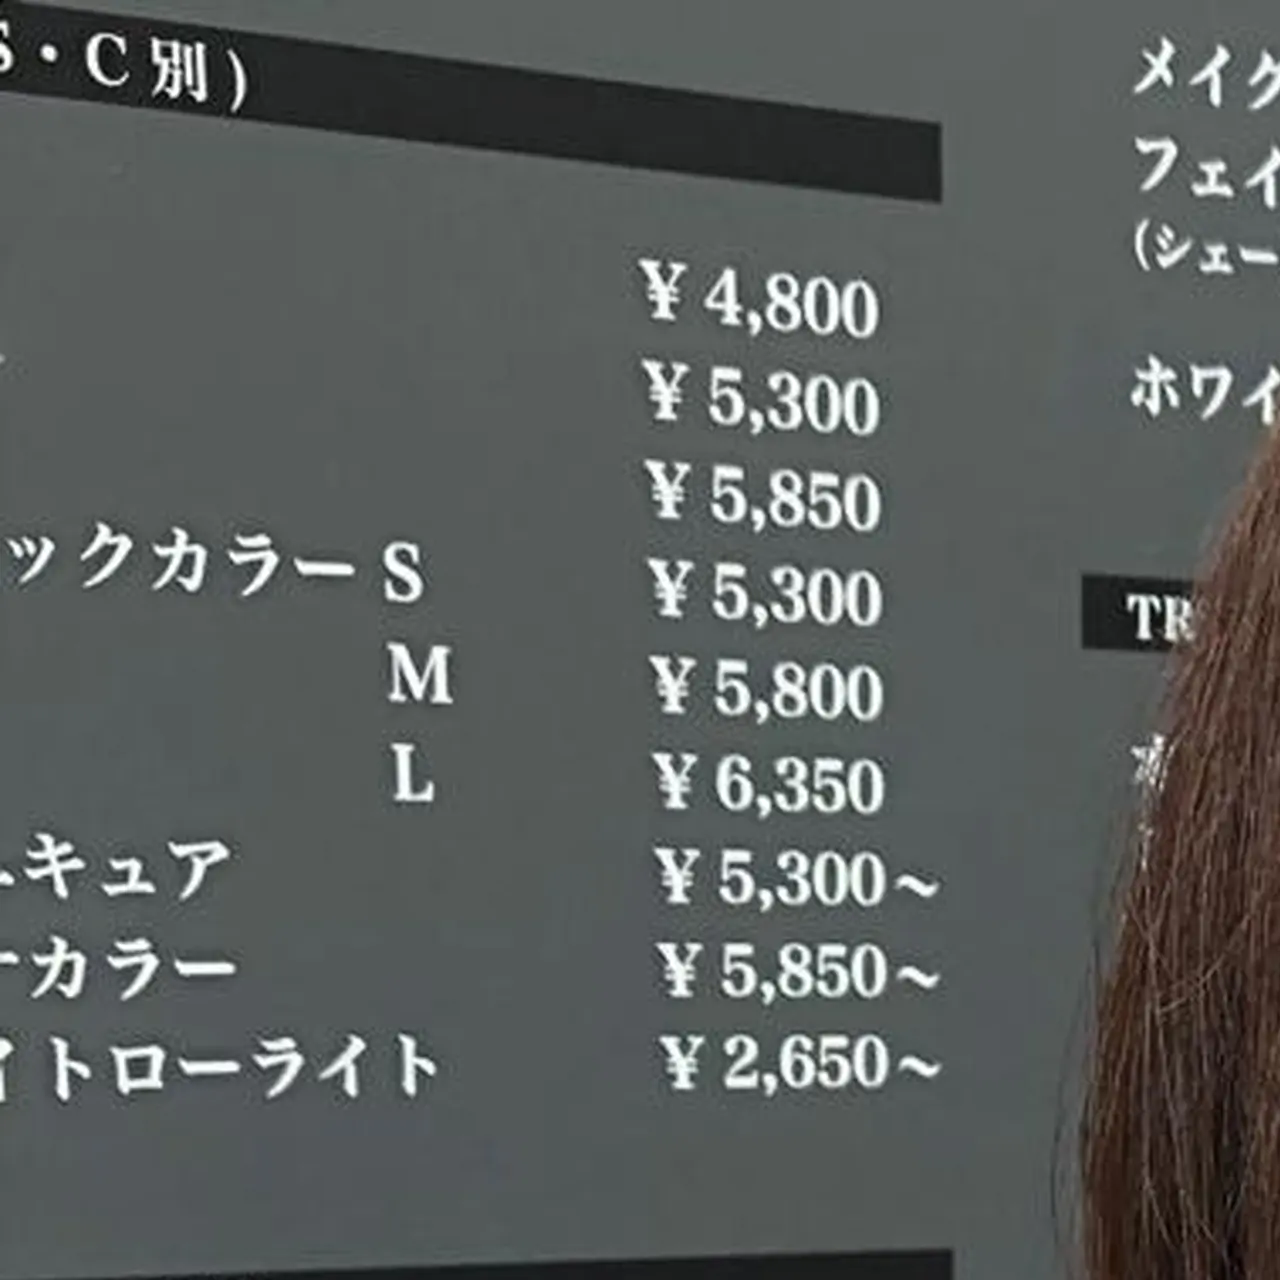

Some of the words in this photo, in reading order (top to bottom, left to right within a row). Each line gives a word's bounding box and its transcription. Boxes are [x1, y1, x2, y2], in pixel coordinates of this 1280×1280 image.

[639, 258, 878, 338] ¥4,800
[642, 359, 879, 435] ¥5,300
[644, 459, 880, 532] ¥5,850
[384, 542, 423, 602] S
[647, 558, 882, 629] ¥5,300
[388, 642, 453, 704] M
[649, 655, 883, 724] ¥5,800
[391, 743, 434, 802] L
[652, 753, 884, 818] ¥6,350
